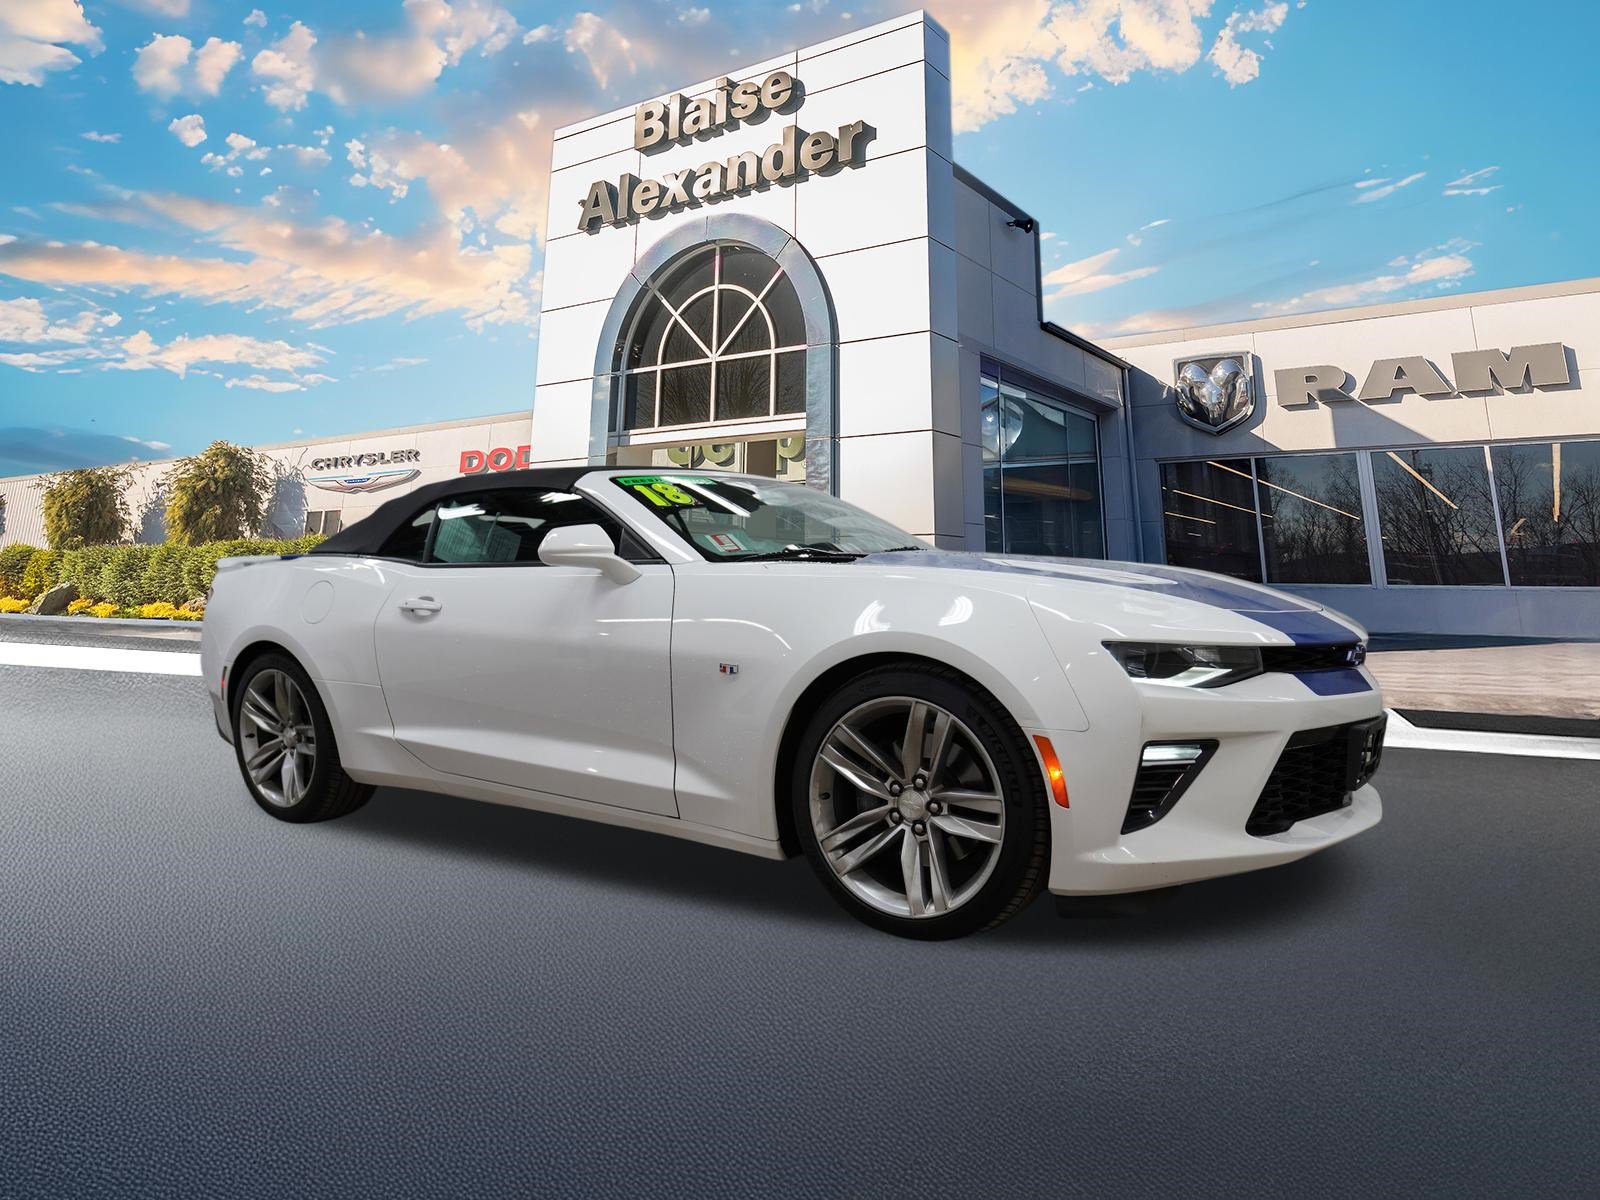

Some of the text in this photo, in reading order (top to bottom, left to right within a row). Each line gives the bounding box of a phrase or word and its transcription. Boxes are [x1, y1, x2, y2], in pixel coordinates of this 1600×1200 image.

[634, 70, 799, 153] Blaise
[577, 120, 872, 232] Alexander
[1274, 342, 1571, 405] RAM
[311, 449, 420, 471] CHRYSLER
[633, 482, 695, 507] 18
